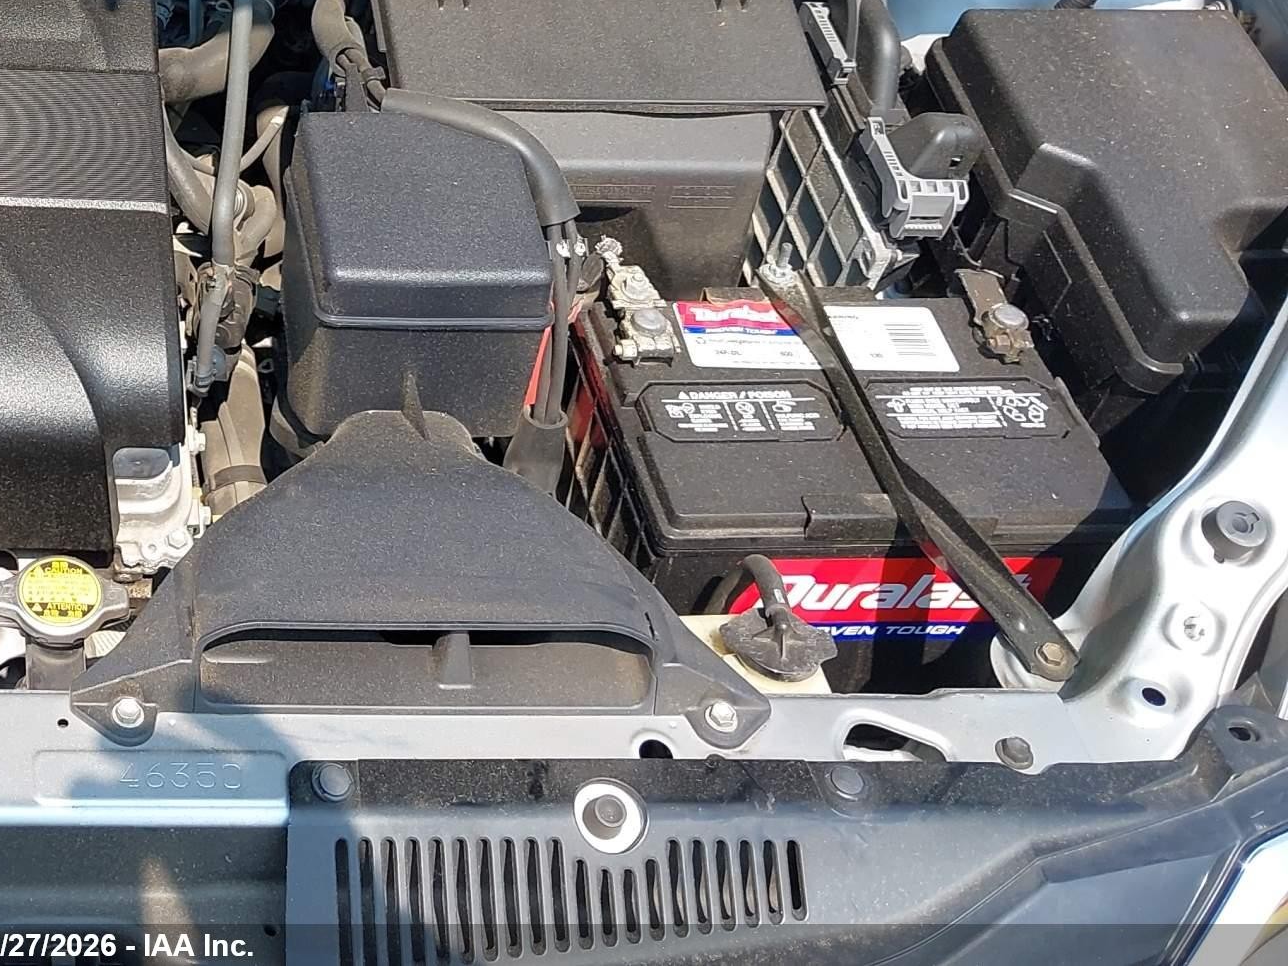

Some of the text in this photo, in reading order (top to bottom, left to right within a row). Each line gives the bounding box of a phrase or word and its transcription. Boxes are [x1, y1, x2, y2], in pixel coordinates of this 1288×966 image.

[689, 391, 738, 399] DANGER
[747, 390, 792, 399] POISON
[45, 566, 83, 575] CAUTION
[47, 602, 88, 611] ATTENTION
[886, 626, 965, 636] TOUGH
